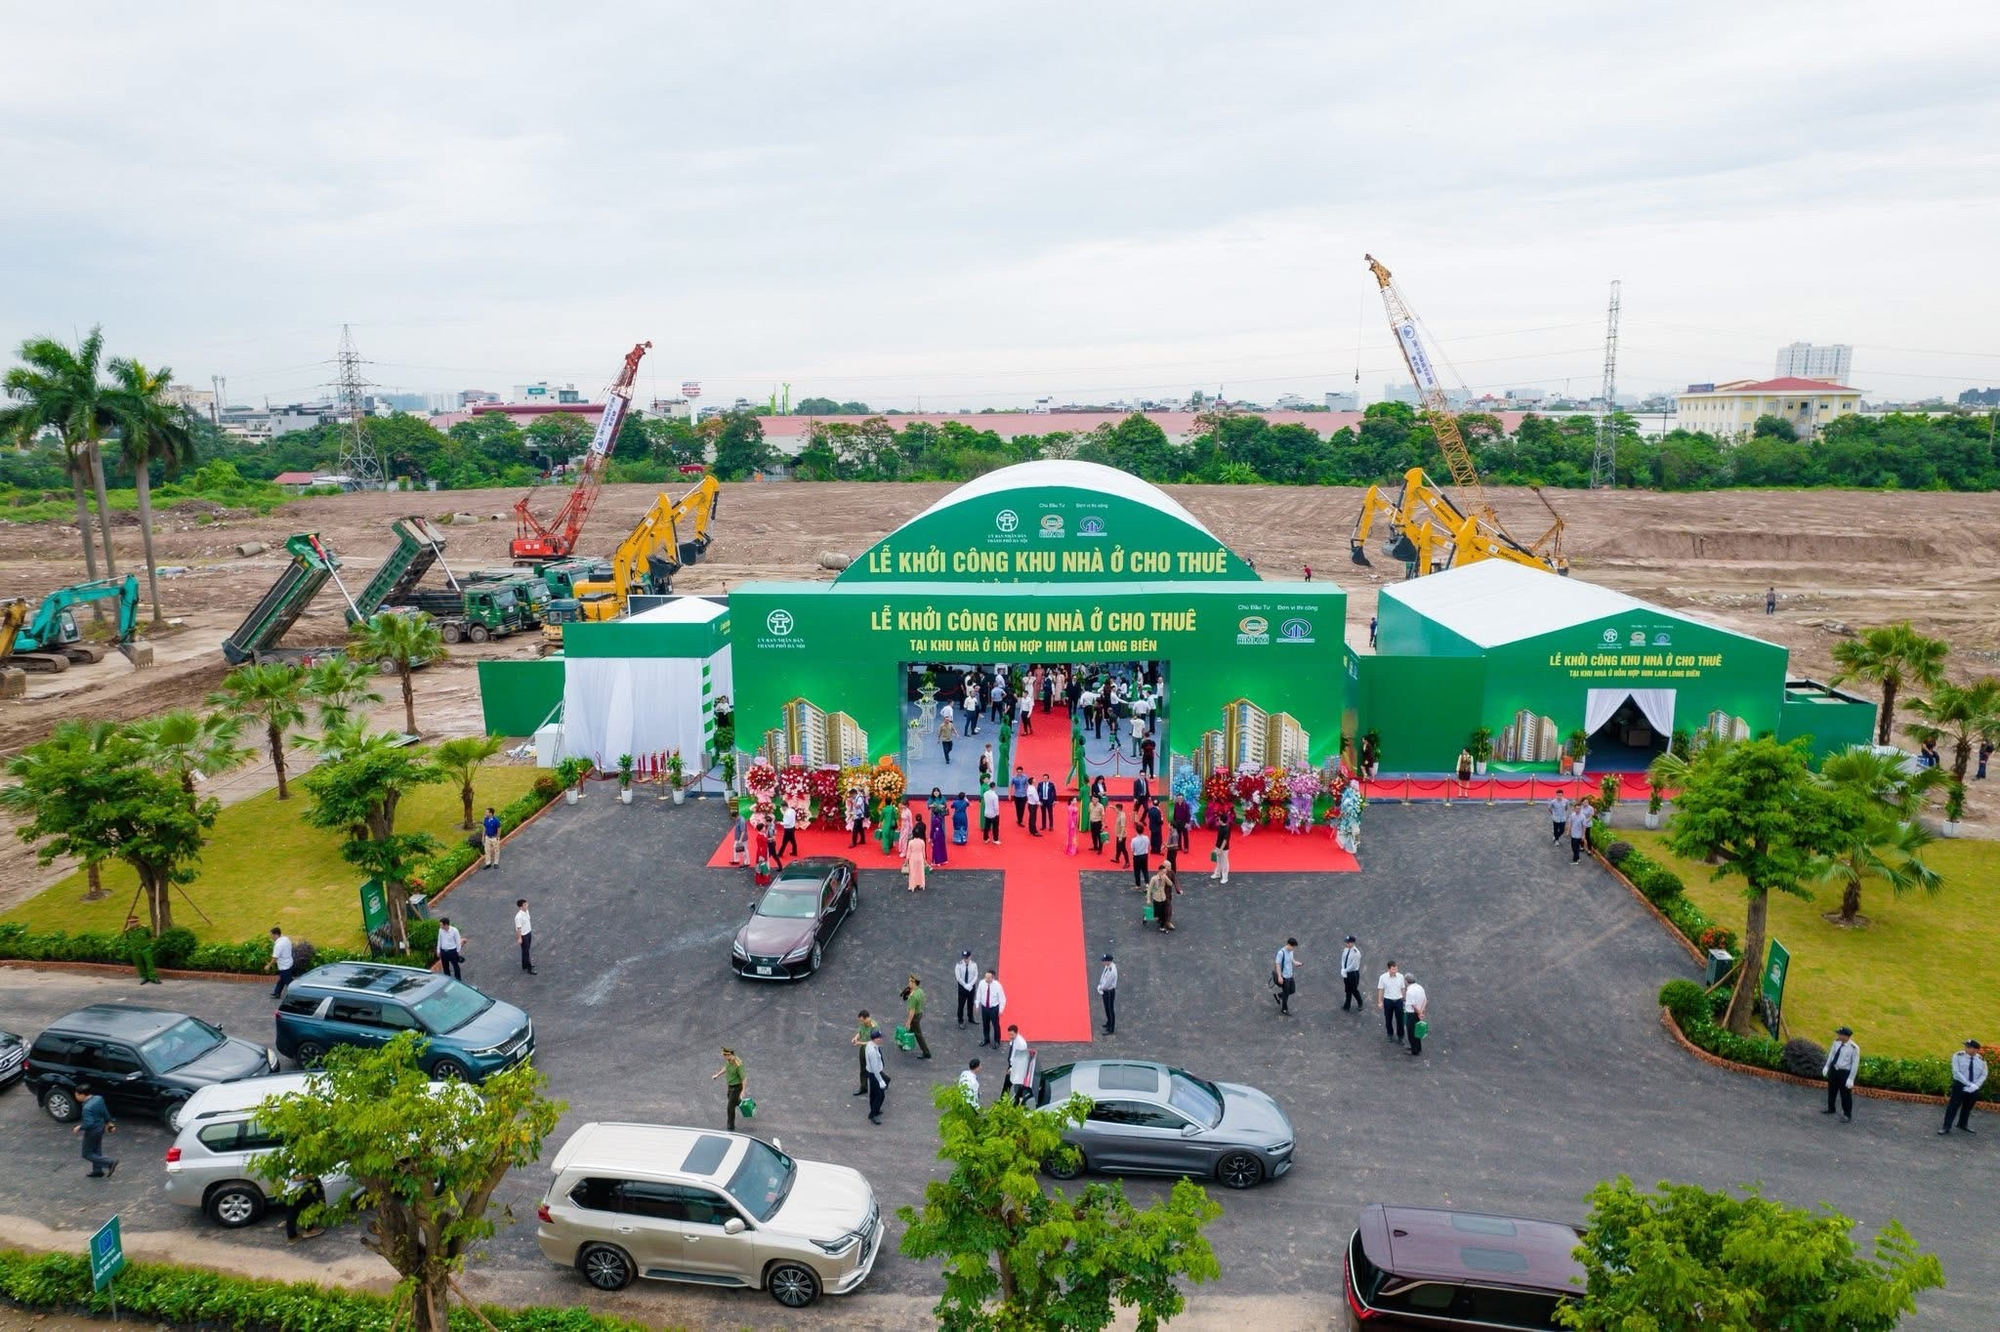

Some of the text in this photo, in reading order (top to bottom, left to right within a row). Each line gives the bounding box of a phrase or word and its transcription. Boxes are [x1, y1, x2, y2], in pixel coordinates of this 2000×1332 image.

[869, 545, 1227, 573] LỄ KHỞI CÔNG KHU NHÀ Ở CHO THUÊ
[871, 604, 1196, 632] LỄ KHỞI CÔNG KHU NHÀ Ở CHO THUÊ
[910, 636, 1157, 655] TẠI KHU NHÀ Ở HỖN HỢP HIM LAM LONG BIÊN
[1549, 652, 1722, 667] LỄ KHỞI CÔNG KHU NHÀ Ở CHO THUÊ
